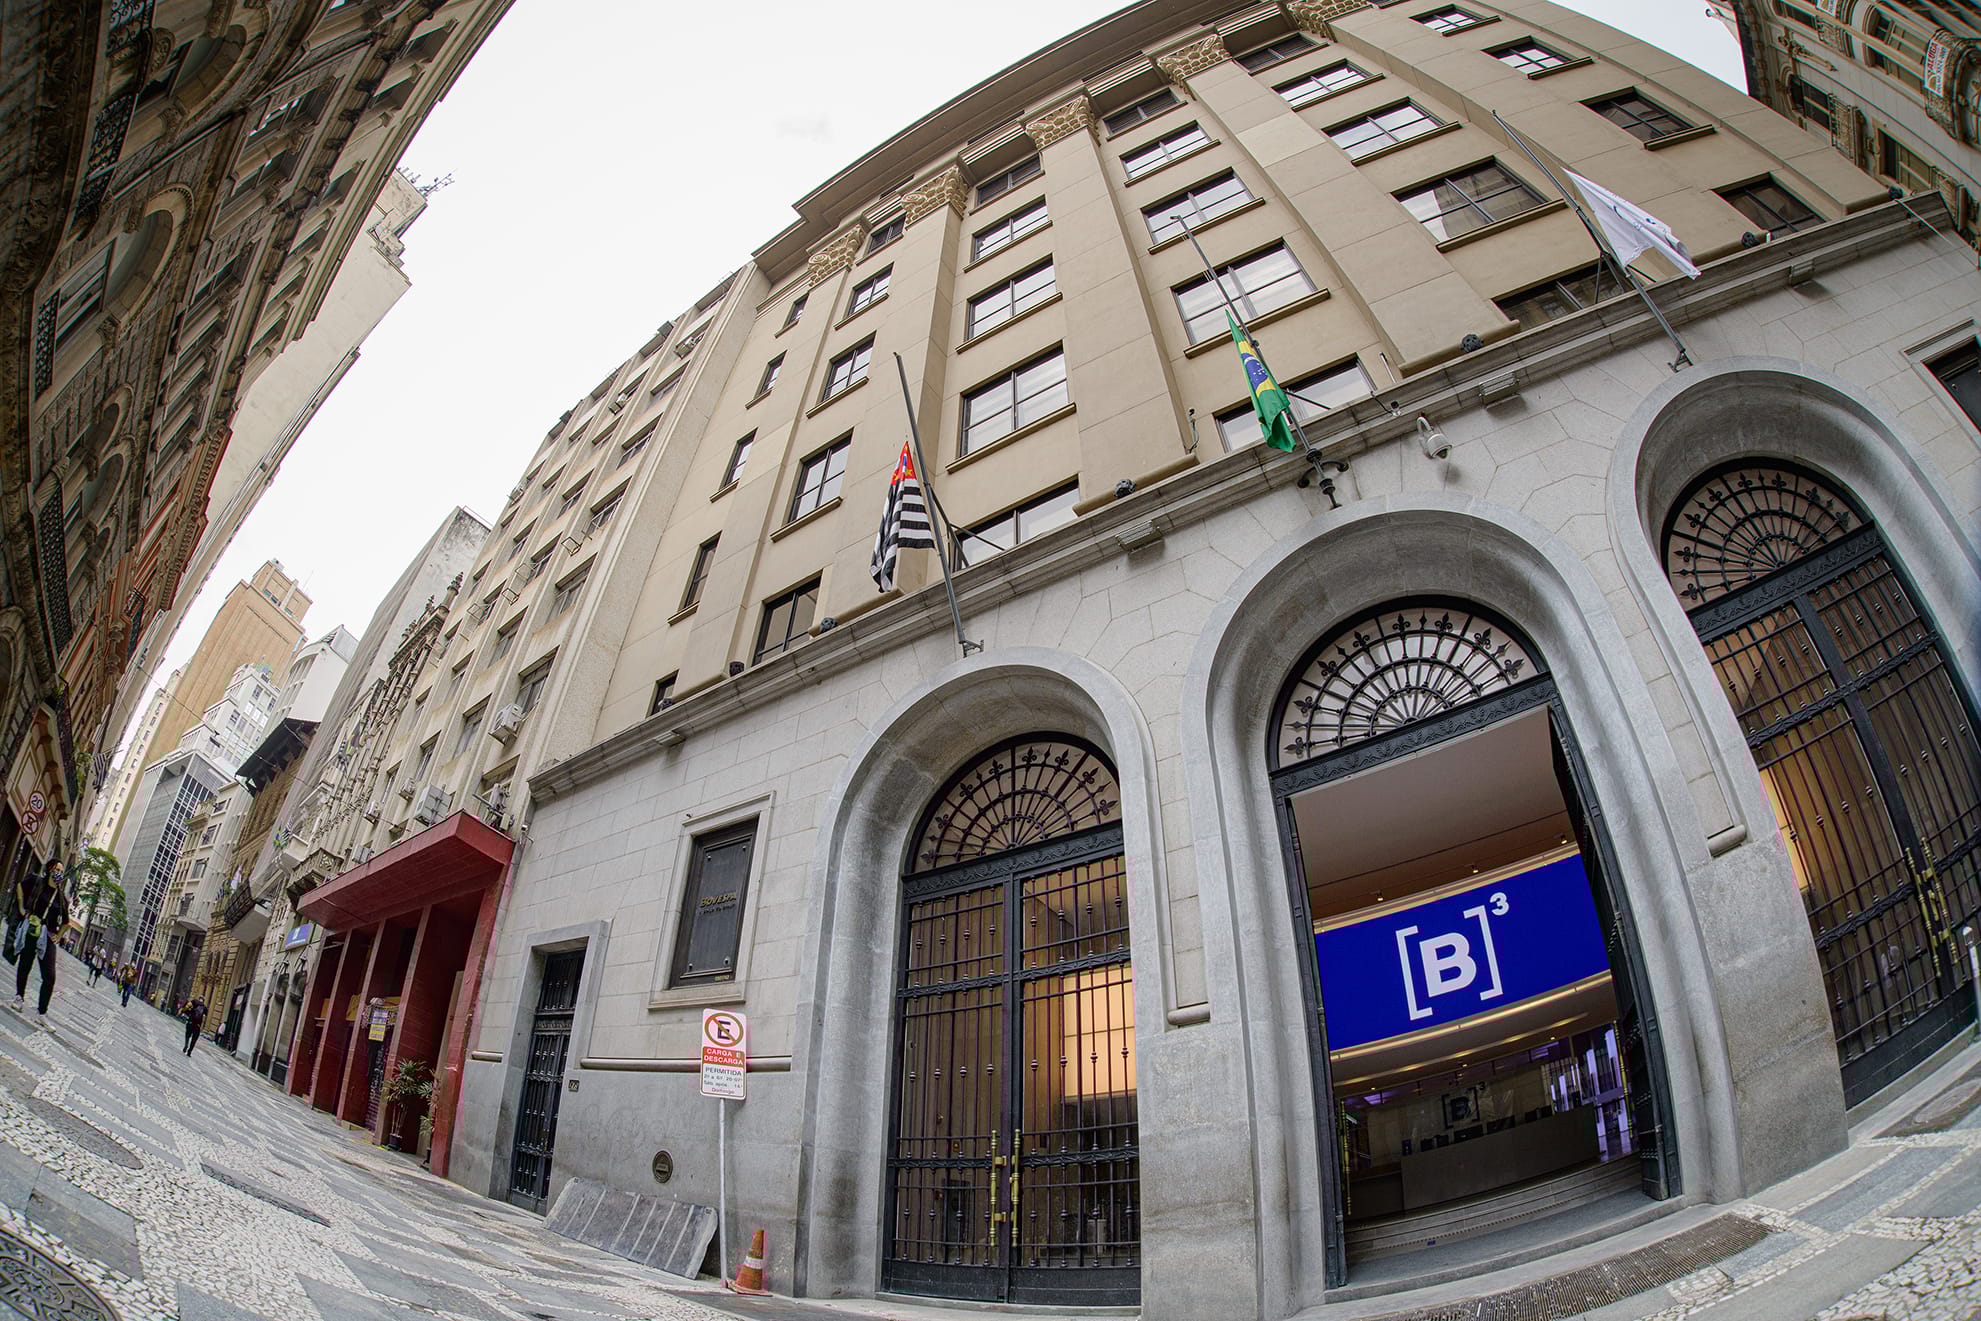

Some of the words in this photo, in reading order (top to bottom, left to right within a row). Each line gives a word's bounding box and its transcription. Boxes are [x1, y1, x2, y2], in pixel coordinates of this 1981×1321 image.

[31, 795, 43, 809] 20
[717, 1020, 731, 1040] E
[706, 1048, 732, 1057] CARGA
[703, 1055, 743, 1065] DESCARGA
[705, 1066, 742, 1076] PERMITIDA
